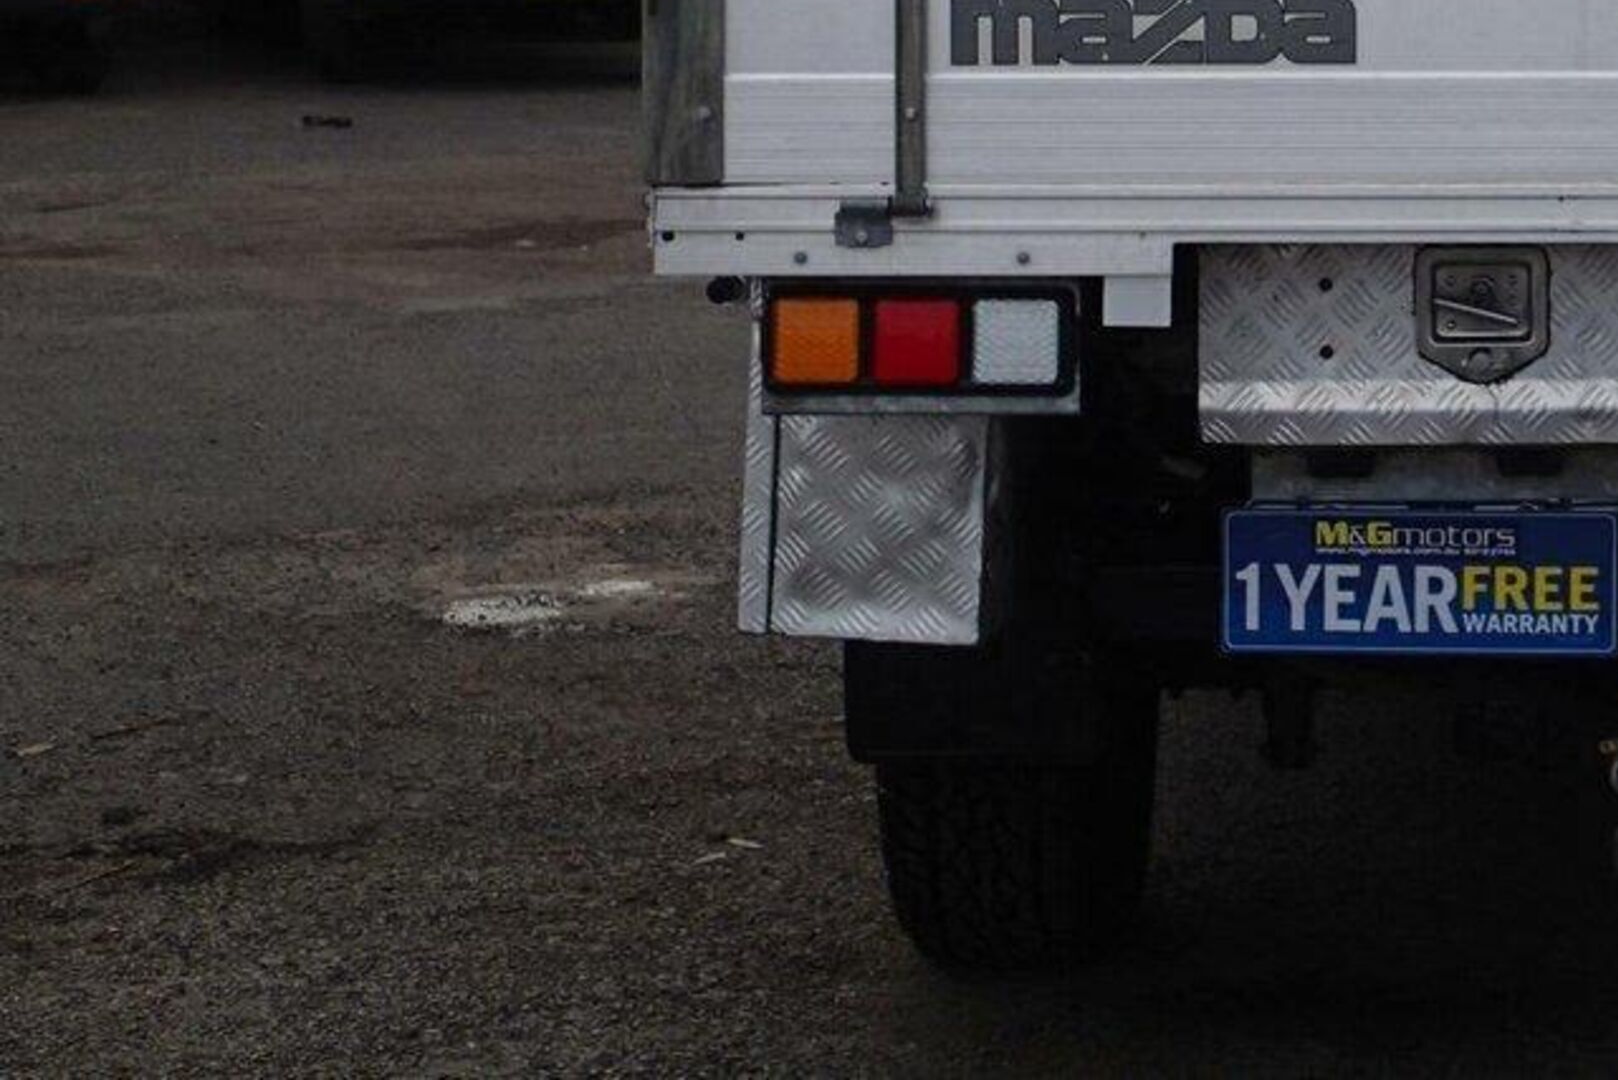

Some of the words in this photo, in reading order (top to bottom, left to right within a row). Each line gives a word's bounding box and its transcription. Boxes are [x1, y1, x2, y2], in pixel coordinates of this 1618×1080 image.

[1236, 563, 1260, 631] 1
[1274, 563, 1459, 633] YEAR
[1460, 566, 1600, 611] FREE
[1462, 612, 1600, 635] WARRANTY
